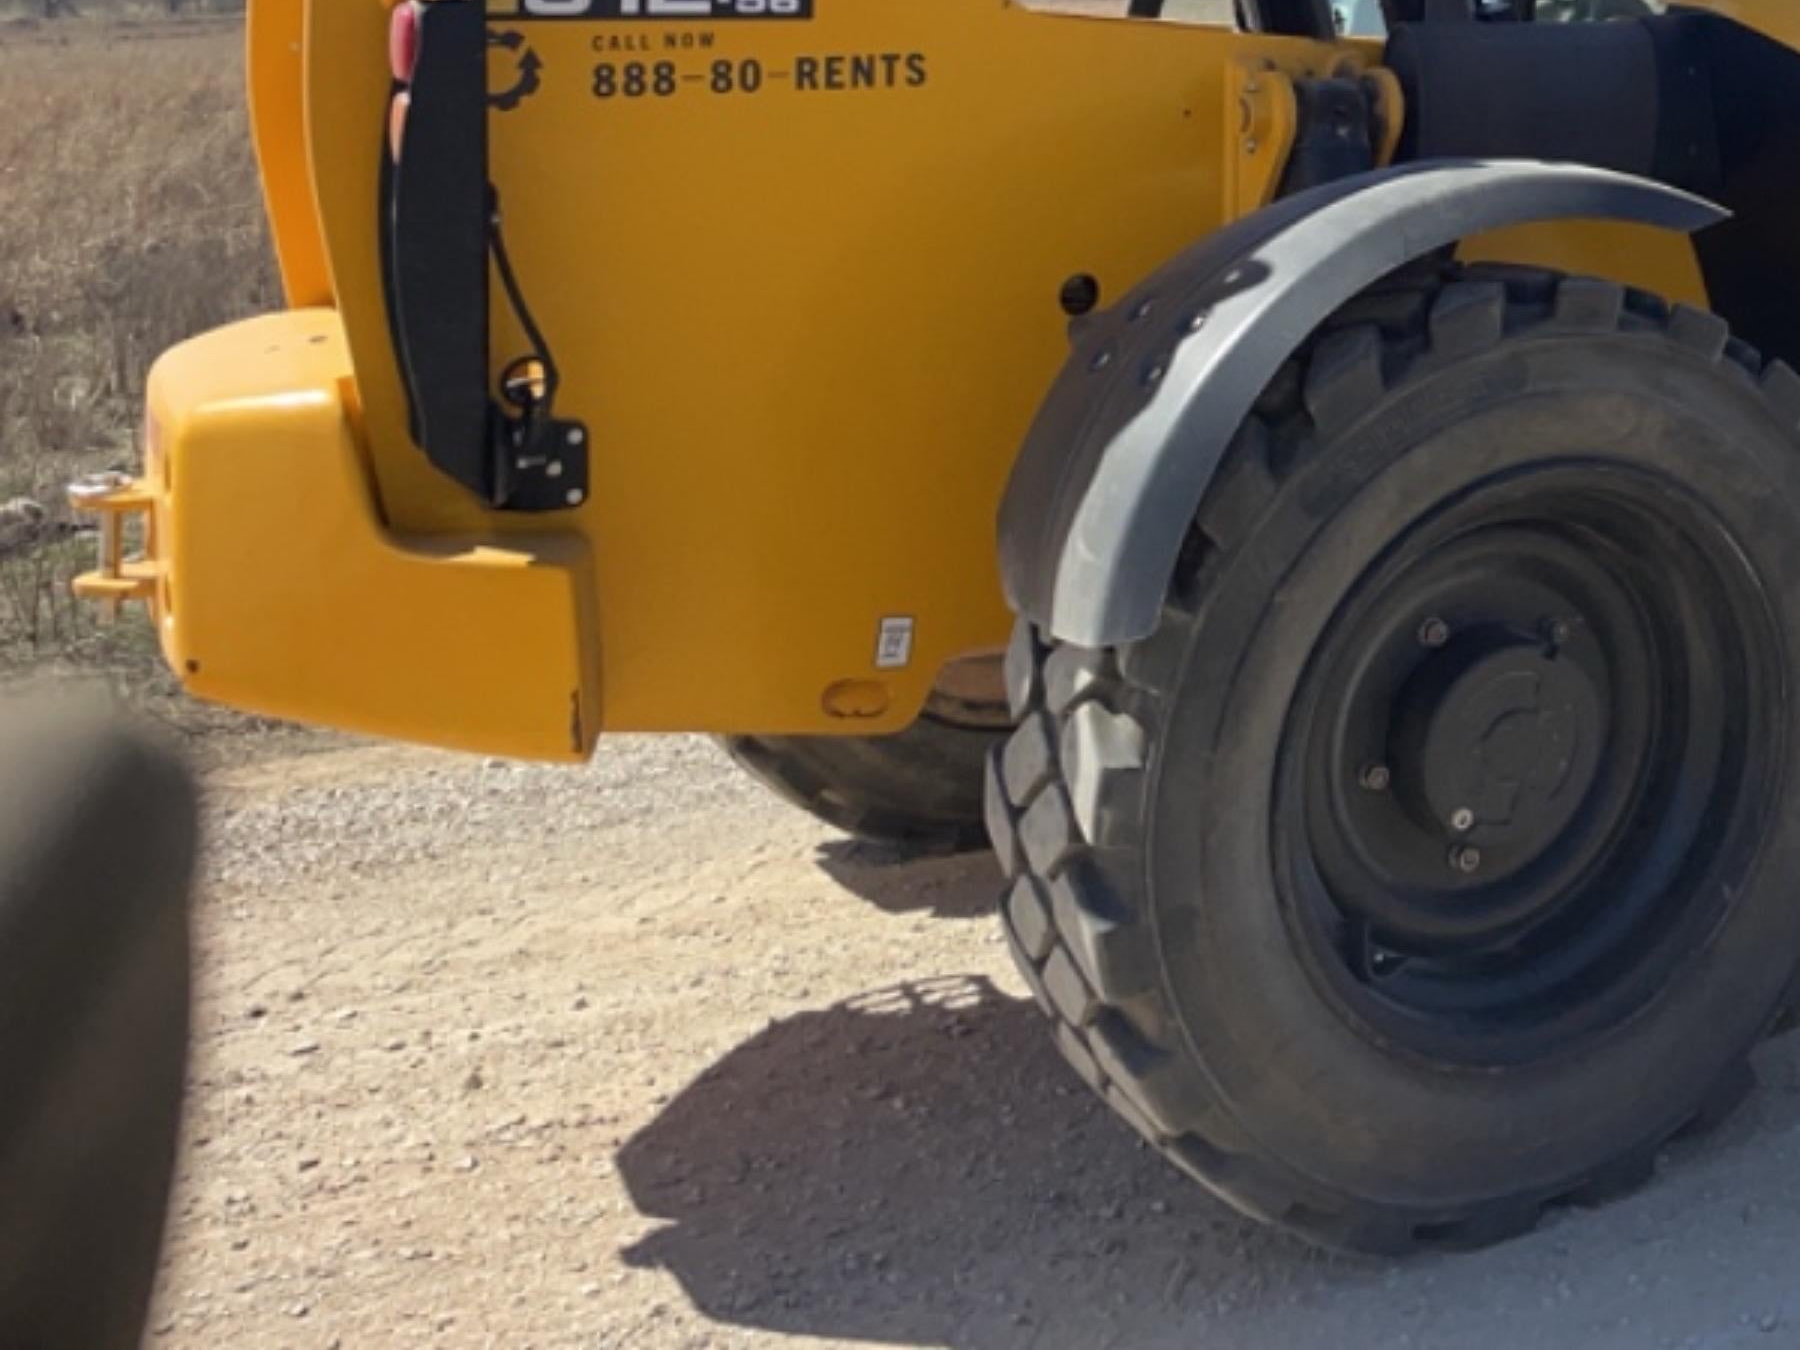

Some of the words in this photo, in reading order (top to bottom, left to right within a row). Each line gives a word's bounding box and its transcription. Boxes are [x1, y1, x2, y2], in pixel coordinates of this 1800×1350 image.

[591, 34, 651, 52] CALL
[663, 31, 716, 50] NOW
[591, 52, 928, 99] 888-80-RENTS
